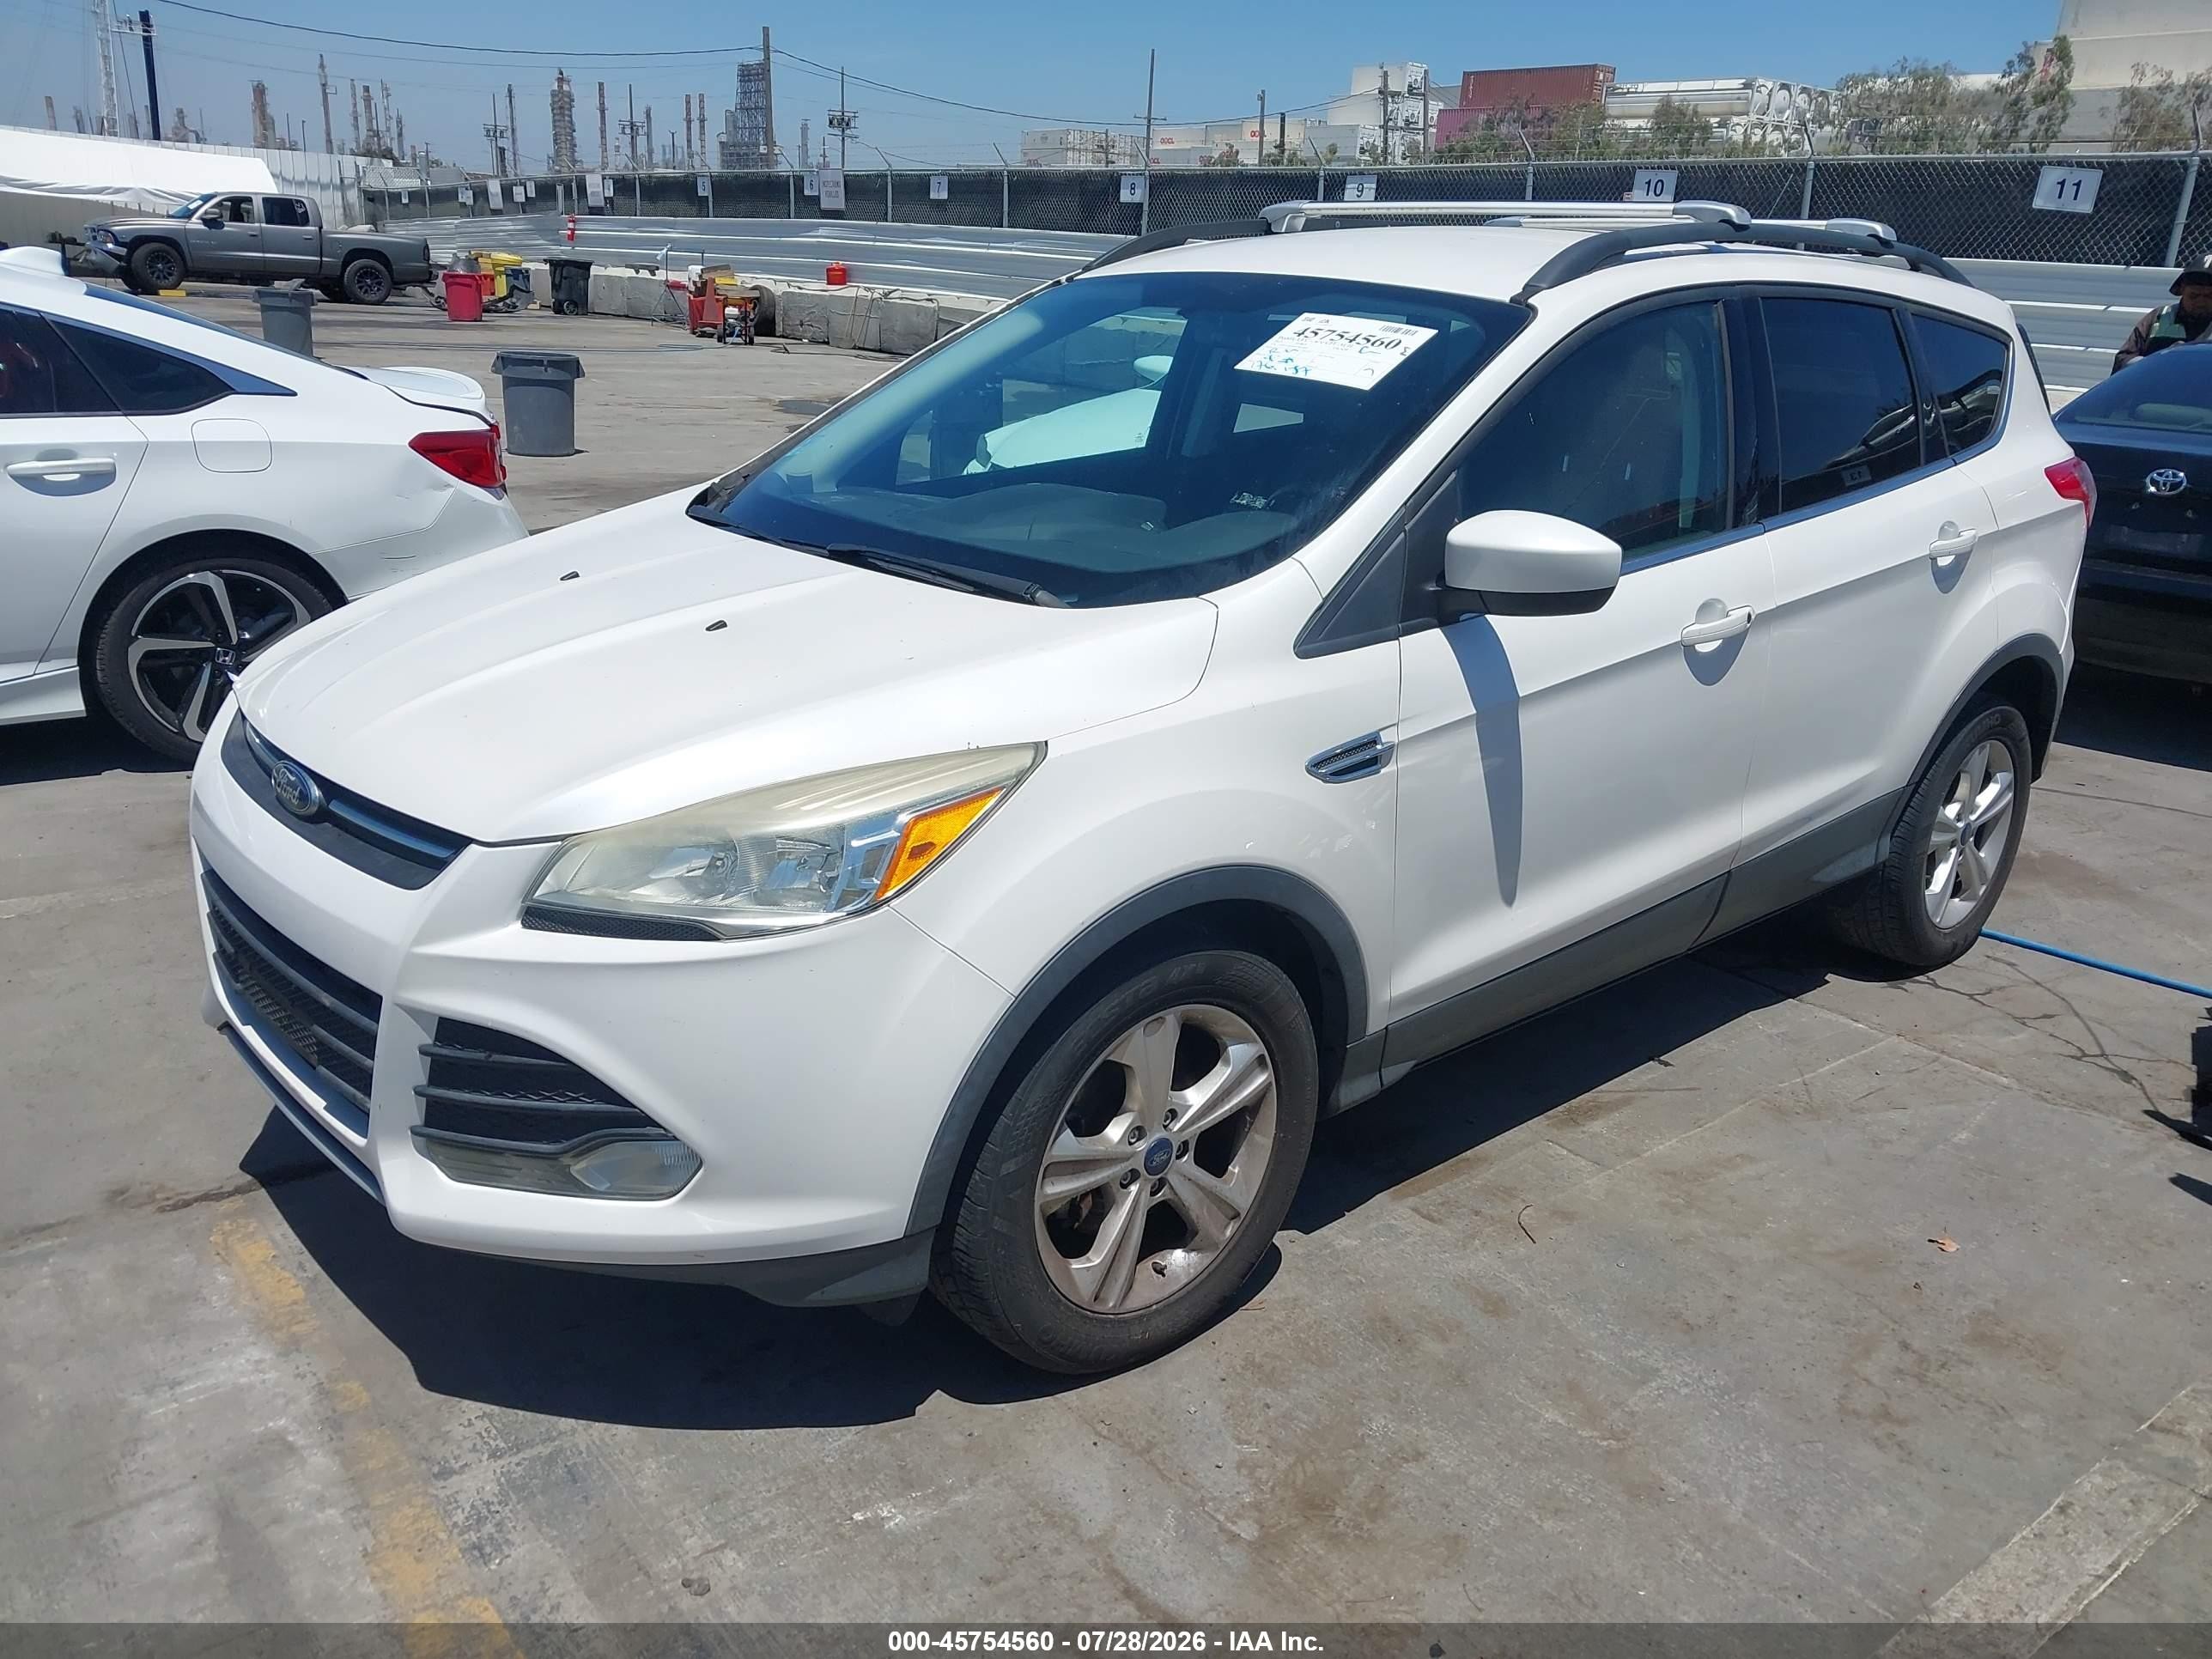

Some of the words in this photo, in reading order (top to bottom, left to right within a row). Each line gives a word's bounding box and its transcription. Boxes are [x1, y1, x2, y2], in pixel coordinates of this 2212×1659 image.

[702, 180, 707, 191] 5
[809, 179, 815, 191] 6
[936, 181, 941, 193] 7
[1129, 182, 1136, 196] 8
[1356, 183, 1364, 198] 9
[1644, 178, 1664, 197] 10
[2057, 178, 2082, 201] 11
[1292, 326, 1402, 350] 45754560
[276, 768, 301, 805] Ford
